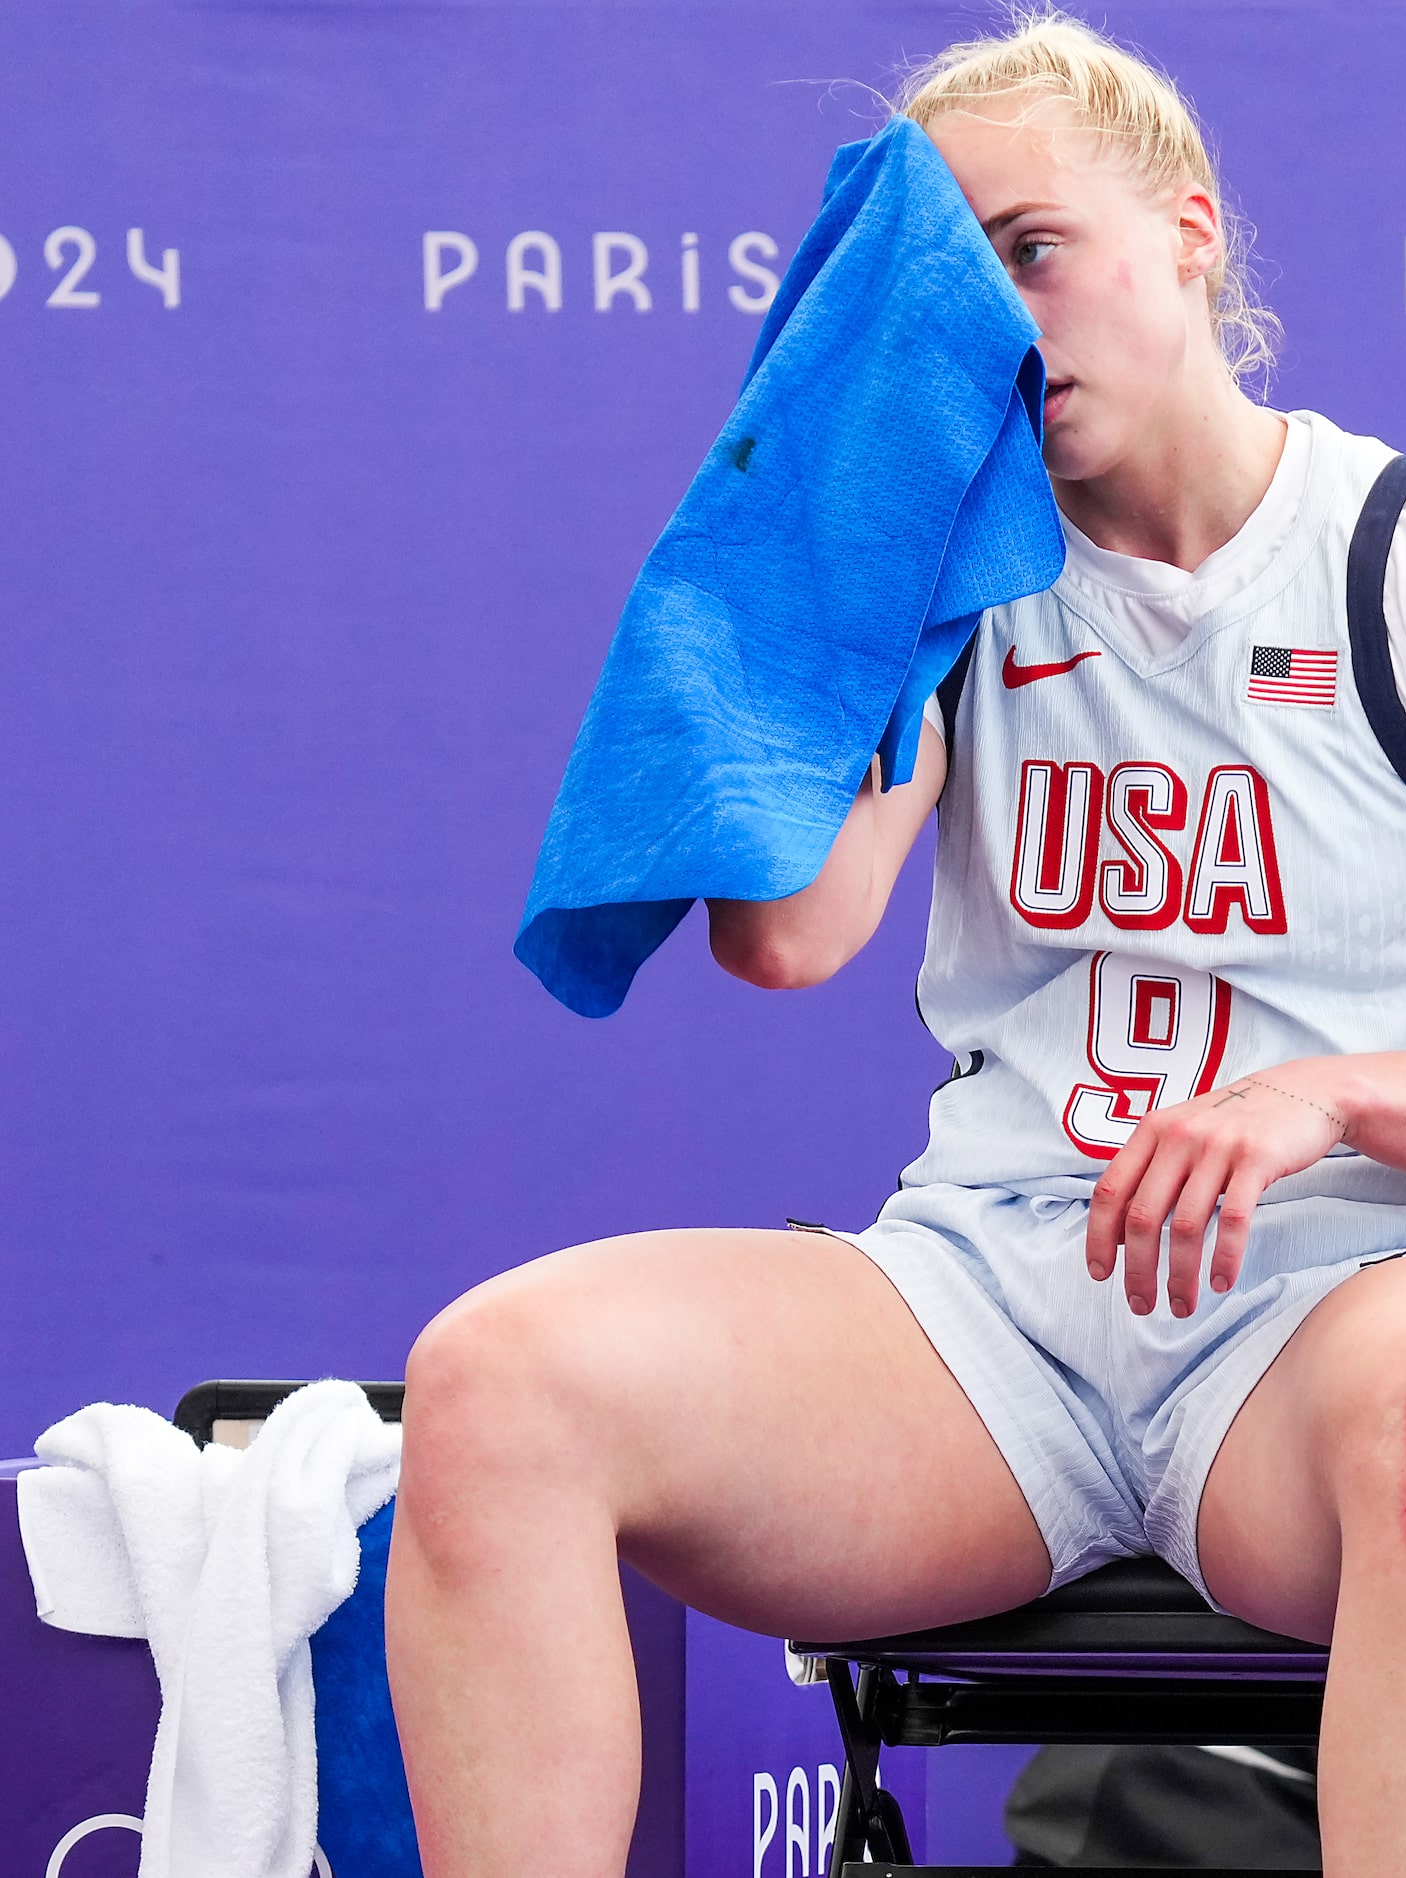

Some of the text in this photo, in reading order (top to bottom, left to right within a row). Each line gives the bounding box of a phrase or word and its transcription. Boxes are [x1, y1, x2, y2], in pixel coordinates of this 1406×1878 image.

[0, 227, 181, 309] 24
[1010, 760, 1288, 935] USA
[1062, 950, 1232, 1161] 9
